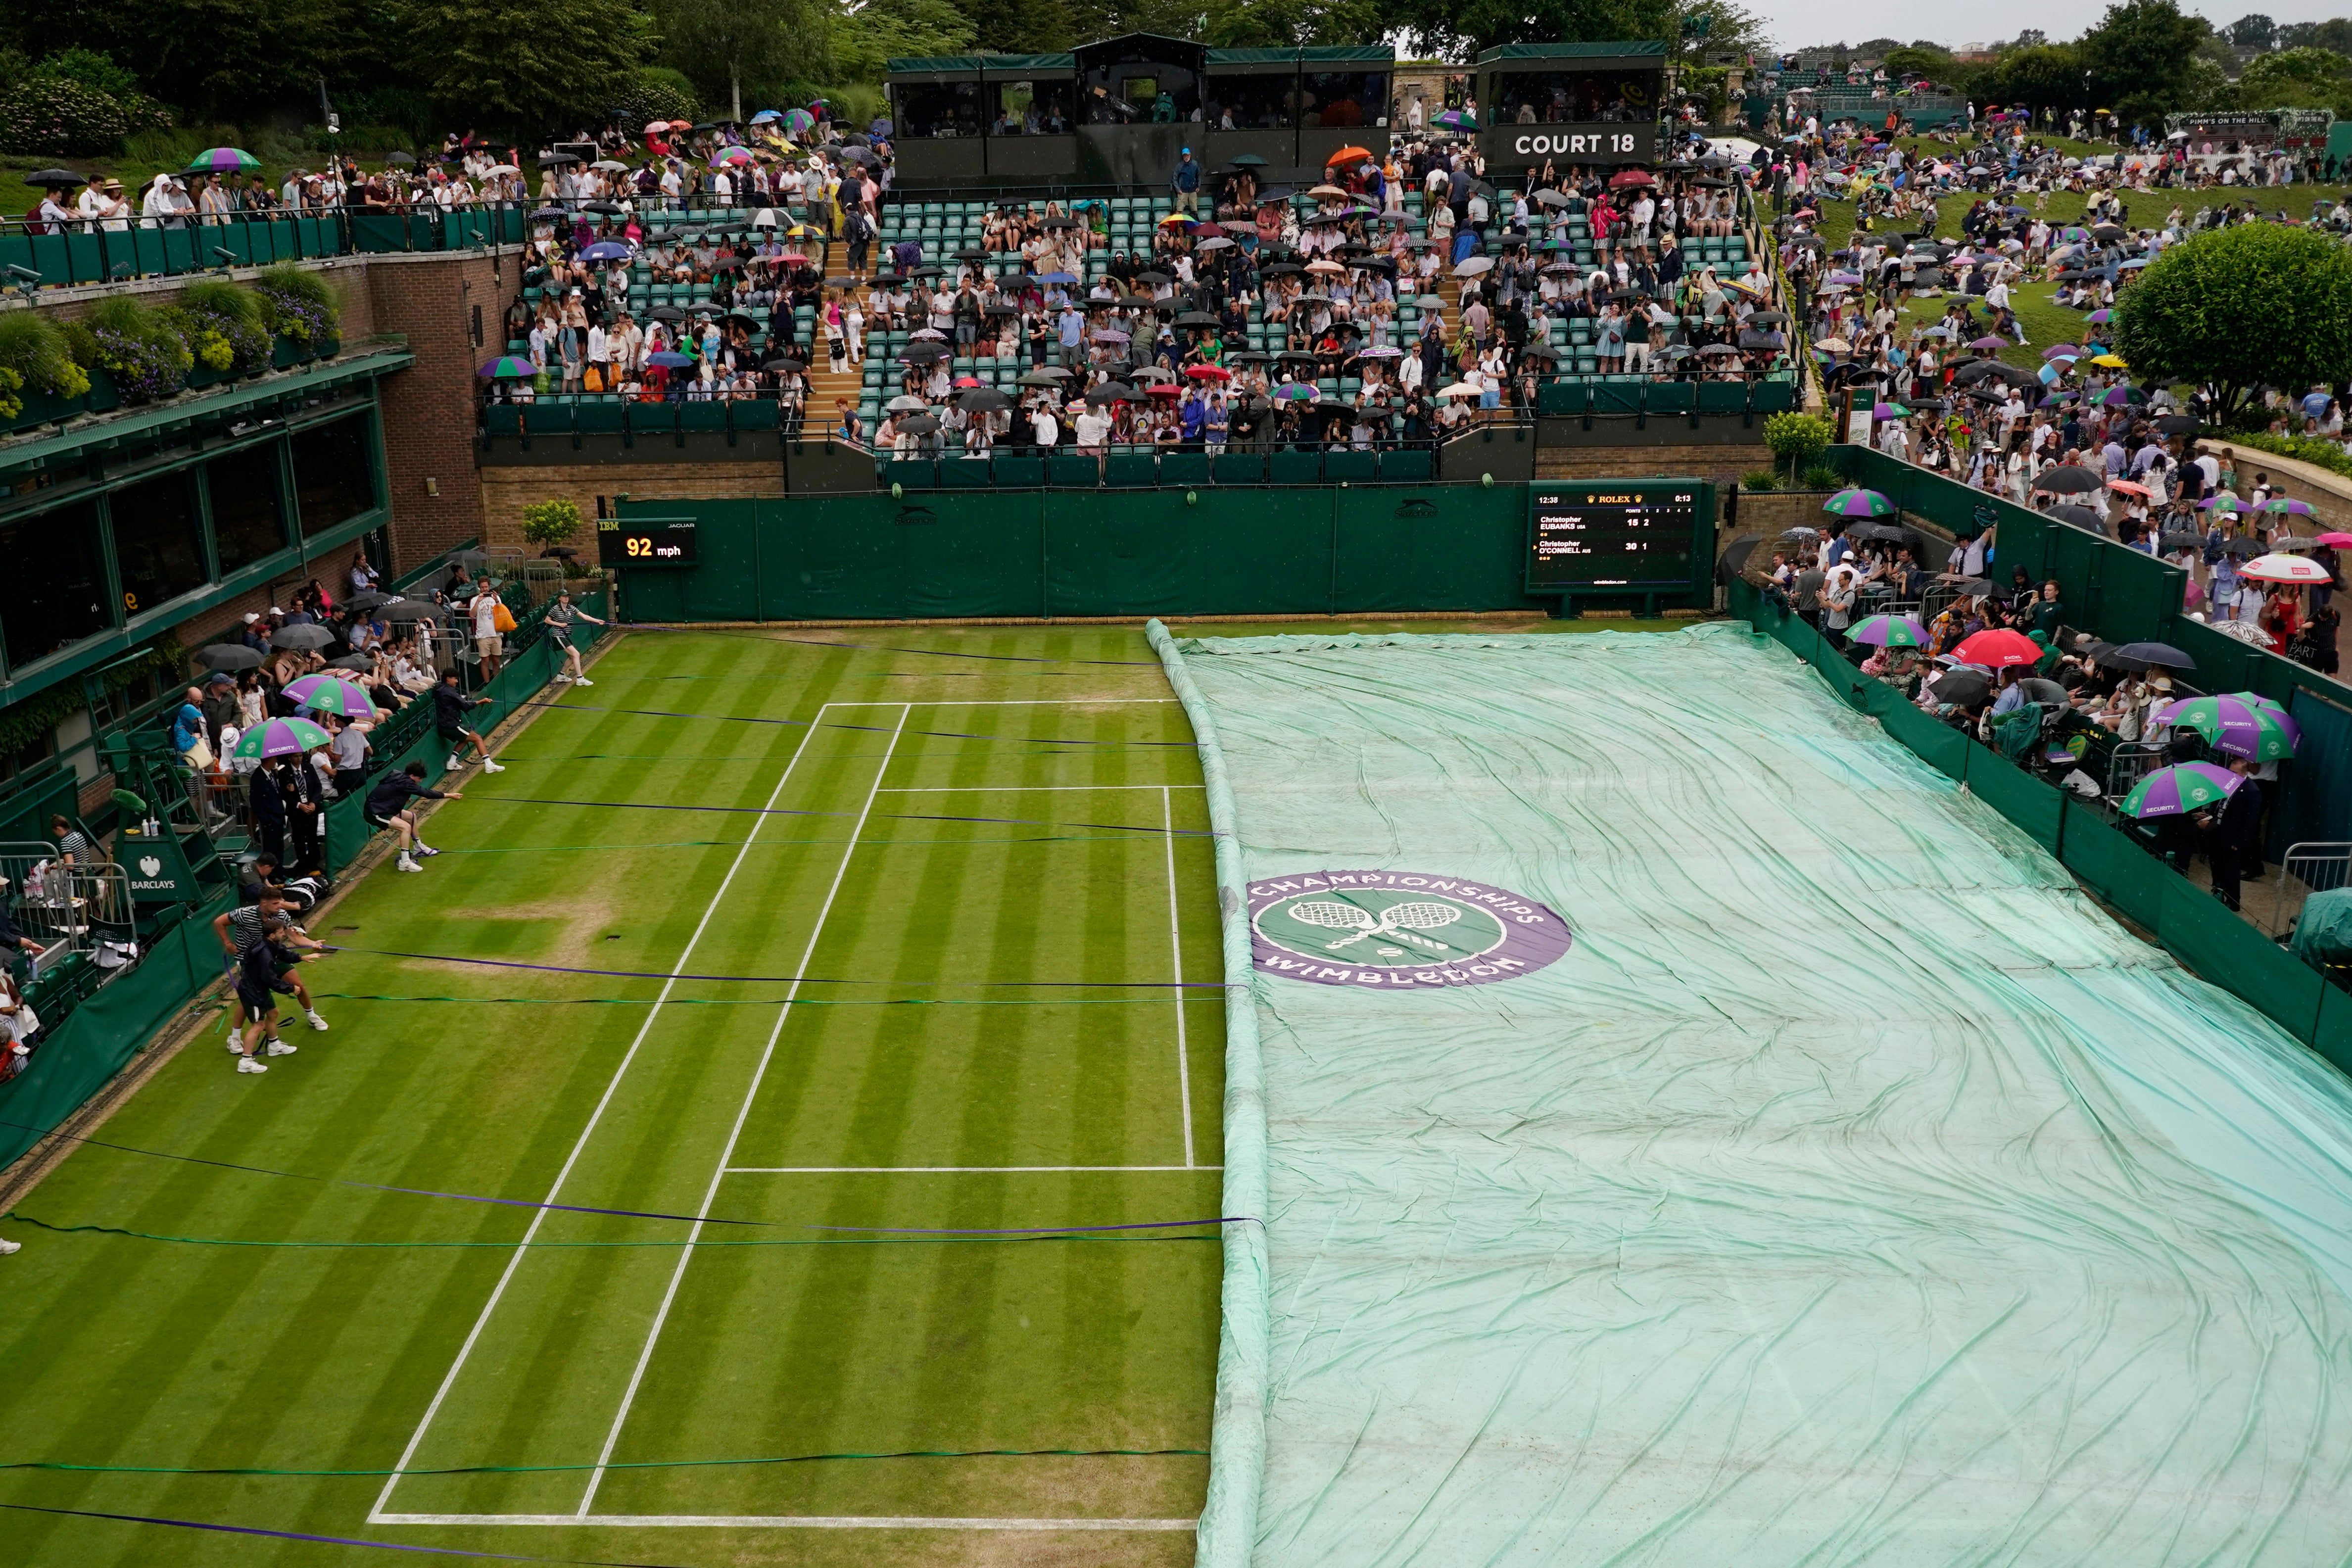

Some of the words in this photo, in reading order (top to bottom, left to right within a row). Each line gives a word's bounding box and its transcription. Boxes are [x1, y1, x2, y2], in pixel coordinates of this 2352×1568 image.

[1515, 135, 1602, 154] COURT
[1611, 134, 1634, 152] 18
[599, 522, 619, 531] IBM
[626, 538, 652, 556] 92
[657, 546, 681, 557] mph
[2289, 643, 2317, 658] PART
[288, 690, 305, 700] SECURITY
[268, 745, 295, 754] SECURITY
[2222, 742, 2251, 755] SECURITY
[2224, 777, 2238, 790] SECURITY
[131, 880, 175, 889] BARCLAYS
[1250, 873, 1544, 924] CHAMPIONSHIPS
[1264, 955, 1525, 984] WIMBLEDON
